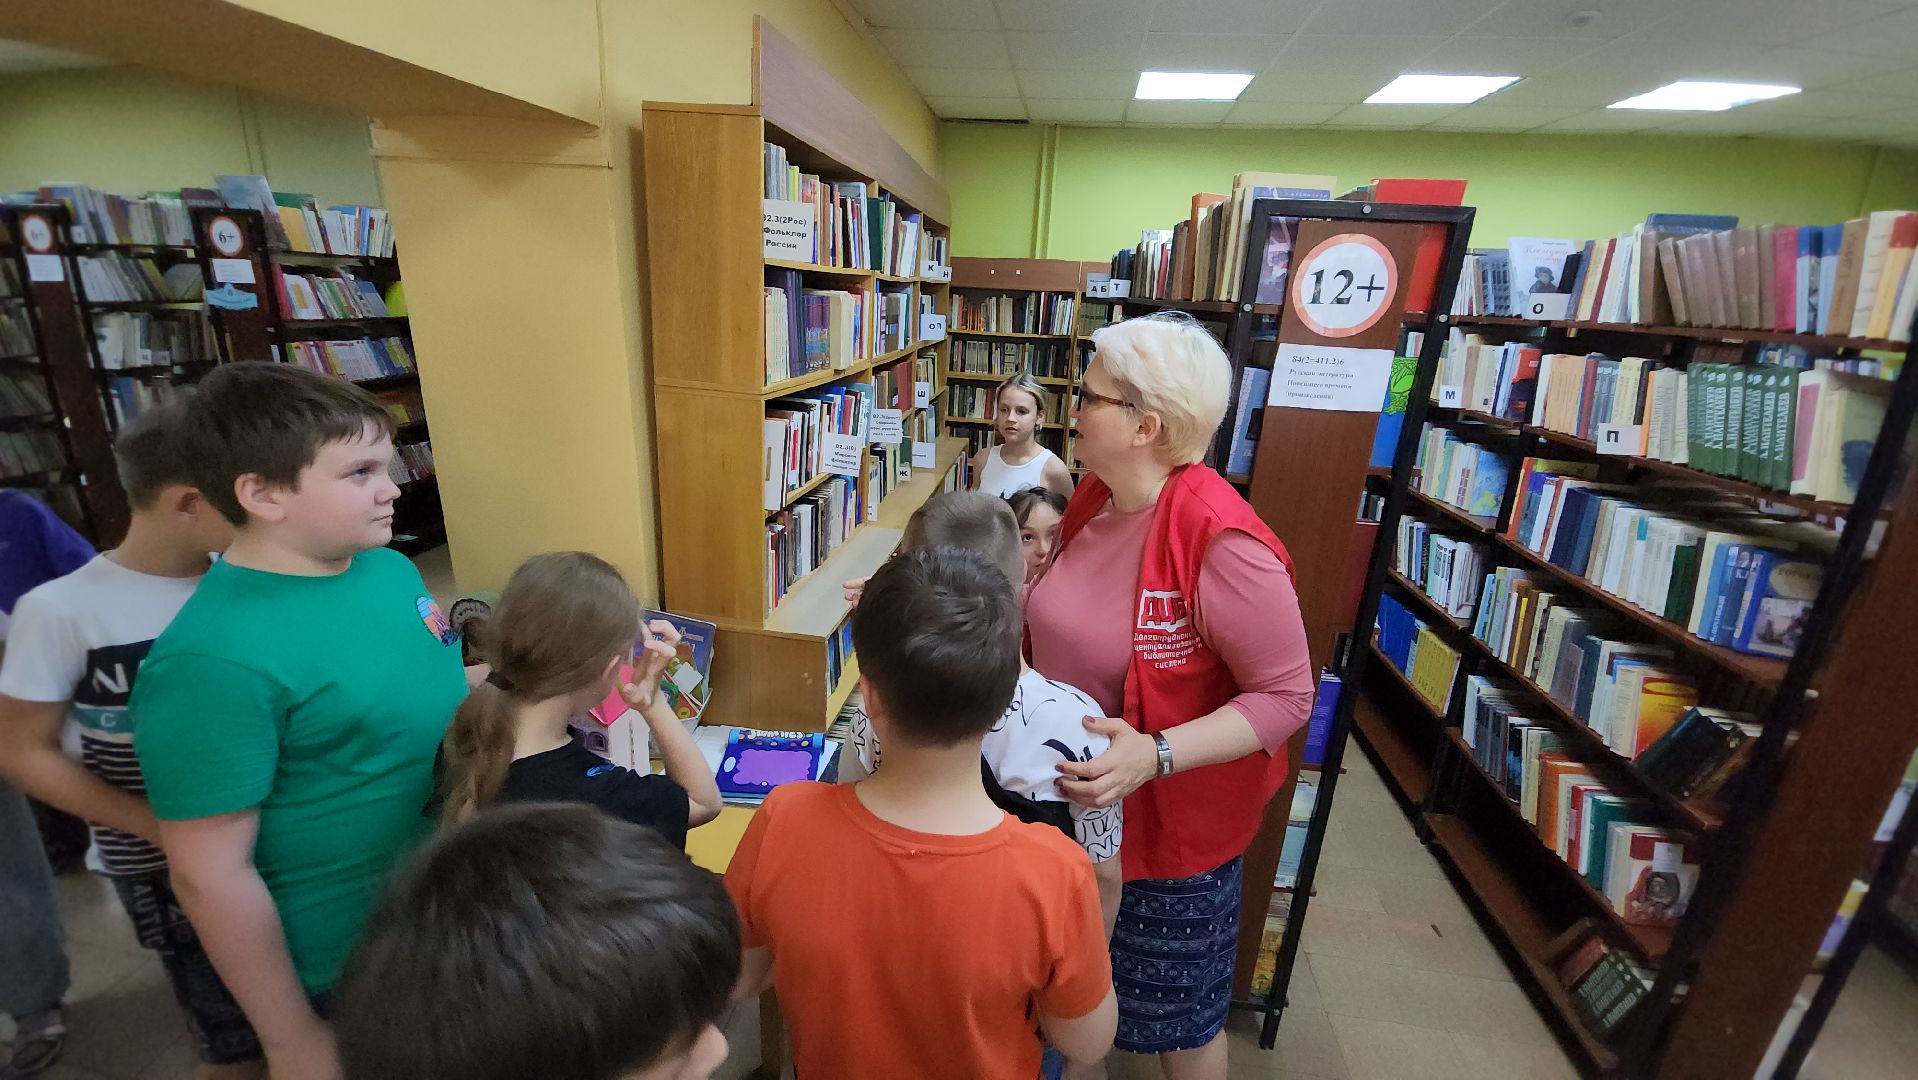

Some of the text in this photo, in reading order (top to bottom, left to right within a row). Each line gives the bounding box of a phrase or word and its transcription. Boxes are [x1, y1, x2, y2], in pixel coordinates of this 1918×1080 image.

[219, 231, 236, 244] 6+
[763, 227, 807, 239] Фольклор
[765, 239, 797, 249] России
[1306, 268, 1385, 305] 12+
[1533, 303, 1544, 315] О
[1445, 391, 1455, 400] М
[1606, 430, 1620, 443] П
